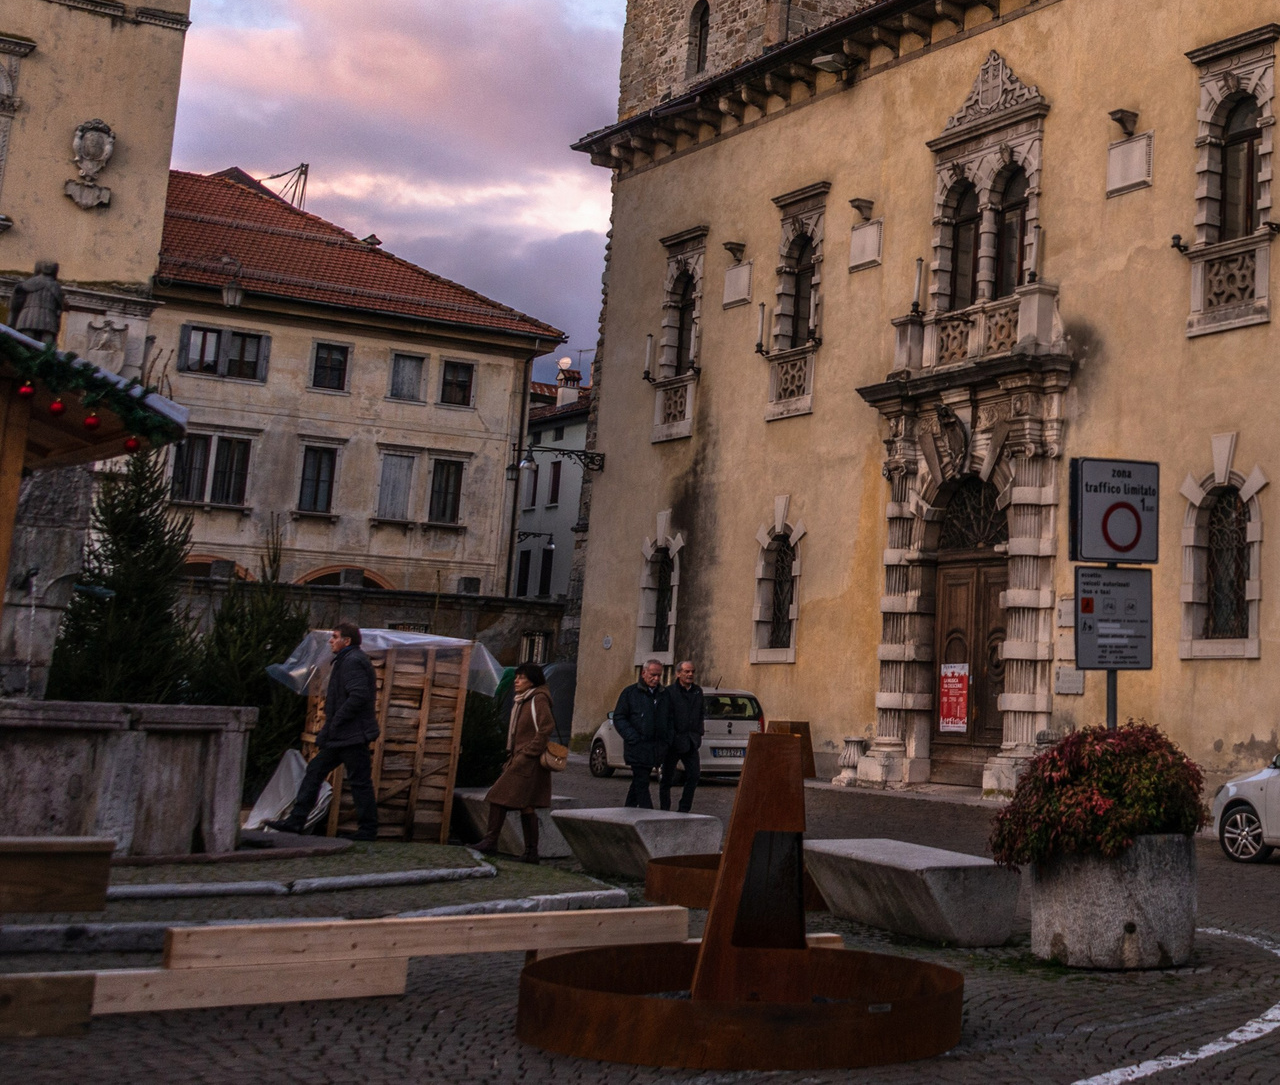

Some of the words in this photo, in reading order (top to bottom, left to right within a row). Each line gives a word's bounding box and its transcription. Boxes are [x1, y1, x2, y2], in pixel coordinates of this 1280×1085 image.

[1112, 468, 1132, 479] zona
[1085, 481, 1121, 494] traffico
[1124, 483, 1157, 497] limitato
[1140, 497, 1145, 512] 1
